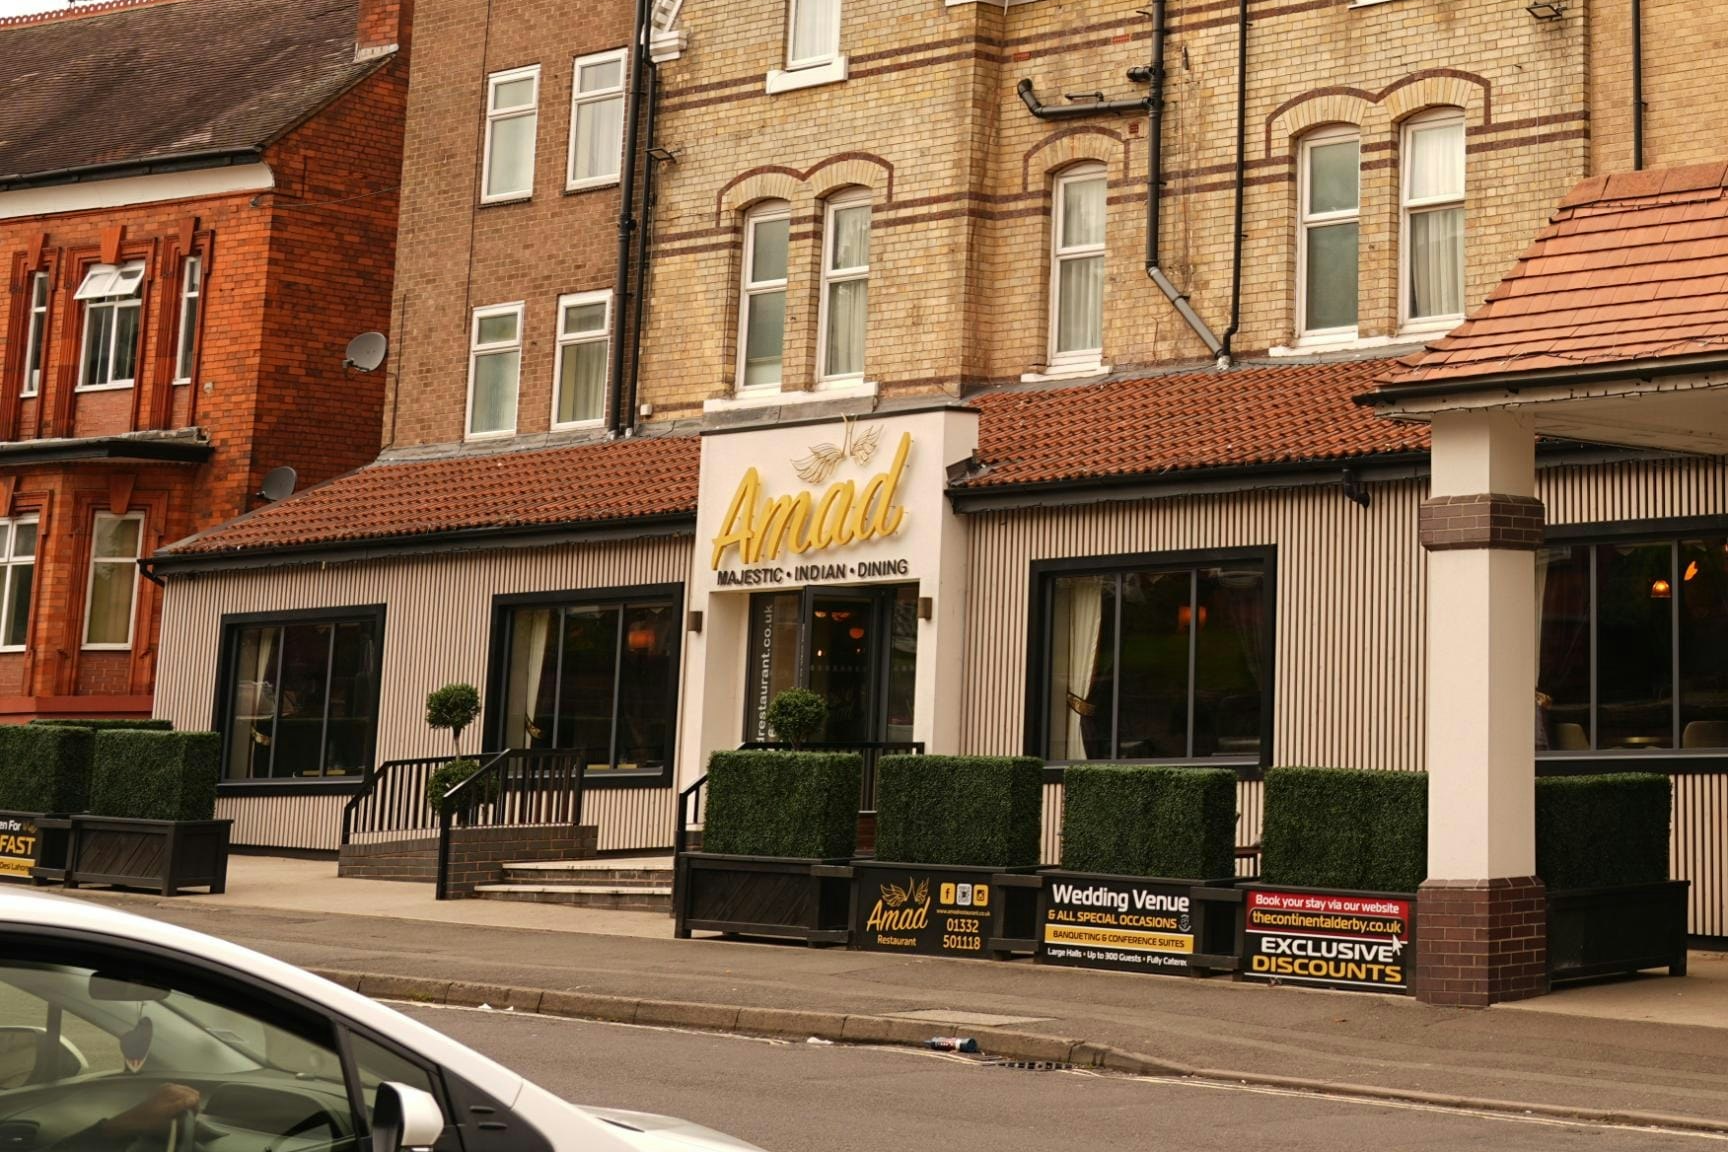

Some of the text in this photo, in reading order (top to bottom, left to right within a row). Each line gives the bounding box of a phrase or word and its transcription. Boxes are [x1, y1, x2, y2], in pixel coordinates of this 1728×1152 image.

[711, 431, 912, 571] Amad
[717, 559, 909, 586] MAJESTIC INDIAN DINING
[8, 819, 22, 832] For
[1052, 883, 1189, 913] Wedding Venue
[1255, 894, 1399, 914] Book your stay via our website
[866, 896, 931, 932] Amad
[1056, 910, 1075, 922] ALL
[1077, 911, 1117, 925] SPECIAL
[1119, 916, 1177, 929] OCCASIONS
[1252, 911, 1401, 934] thecontinentalderby.co.uk
[946, 918, 979, 933] 01332
[877, 934, 917, 946] Restaurant
[943, 934, 981, 950] 501118
[1053, 930, 1102, 942] BANQUETING
[1108, 934, 1157, 946] CONFERENCE
[1158, 938, 1184, 948] SUITES
[1261, 936, 1394, 962] EXCLUSIVE
[1047, 947, 1066, 957] Large
[1067, 948, 1082, 958] Halls
[1087, 950, 1096, 960] Up
[1097, 951, 1104, 959] to
[1119, 954, 1142, 963] Guests
[1147, 955, 1163, 966] Fully
[1252, 955, 1402, 983] DISCOUNTS
